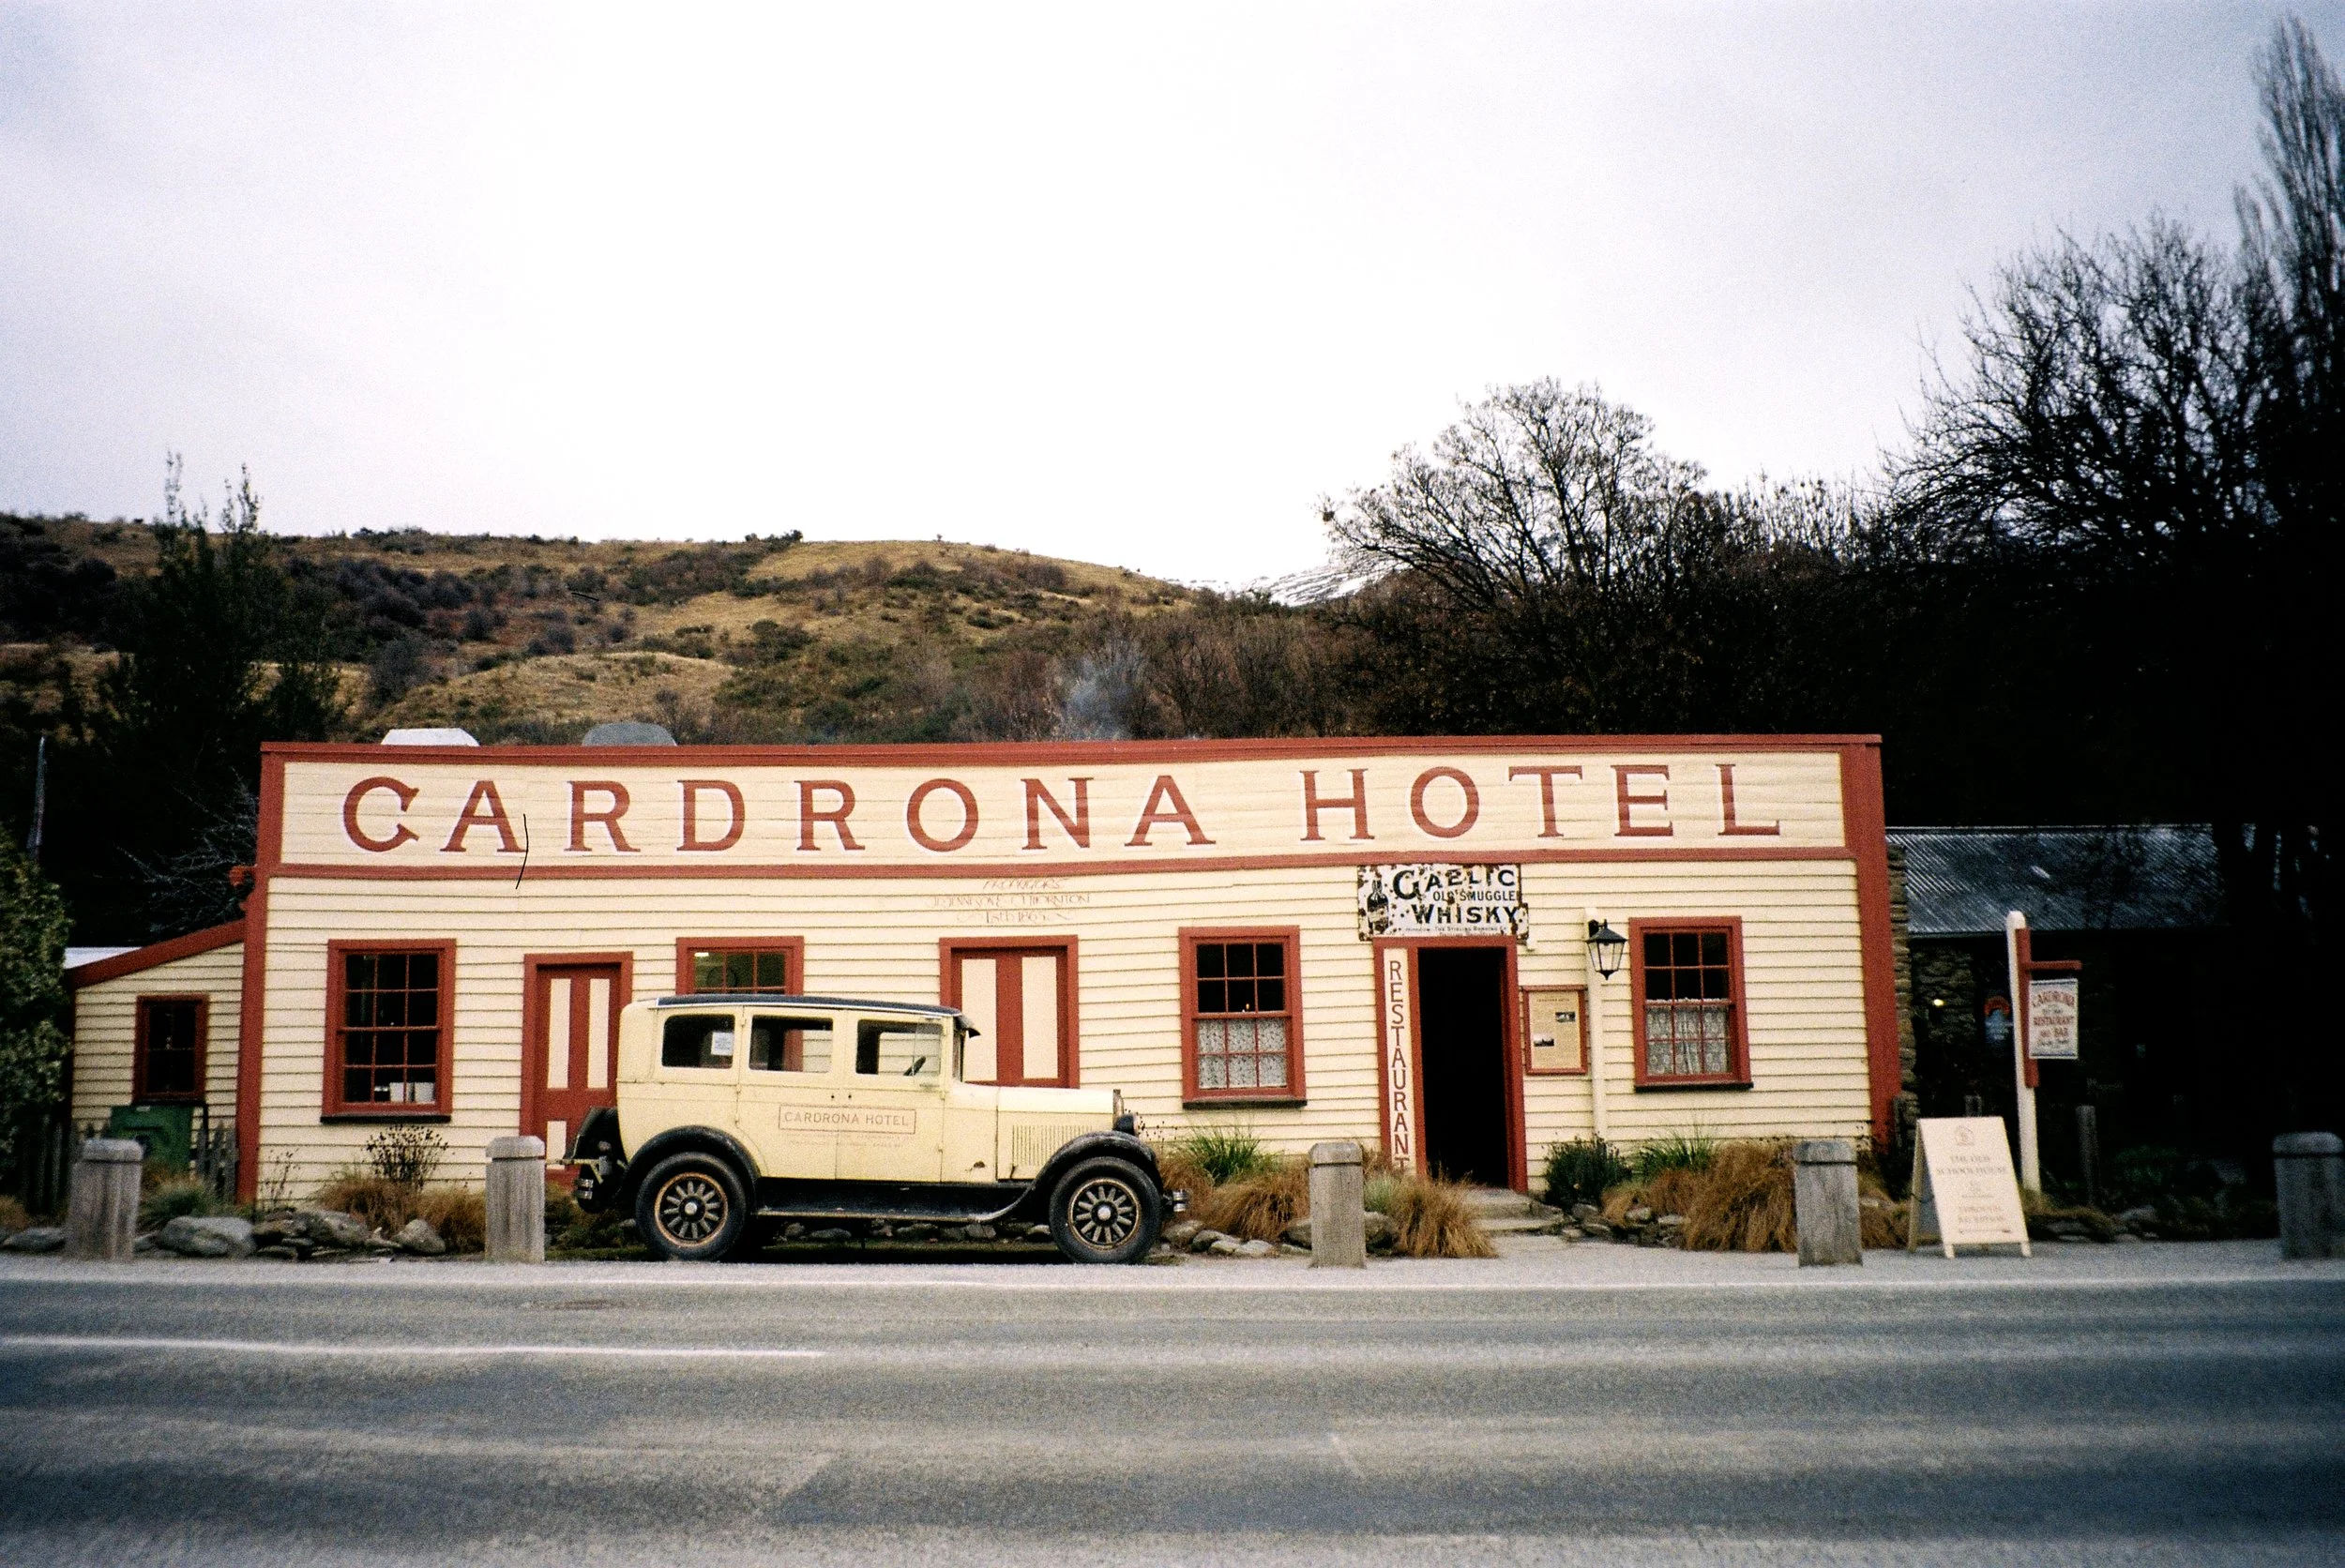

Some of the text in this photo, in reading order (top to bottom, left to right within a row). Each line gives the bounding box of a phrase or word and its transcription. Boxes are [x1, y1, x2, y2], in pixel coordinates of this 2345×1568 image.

[341, 762, 1781, 853] CARDRONA HOTEL
[1393, 868, 1516, 900] GAELIC
[1460, 890, 1520, 902] SMUGGLE
[1411, 903, 1519, 924] WHISKY
[1388, 959, 1410, 1168] RESTAURANT
[783, 1110, 909, 1127] CARDRONA HOTEL
